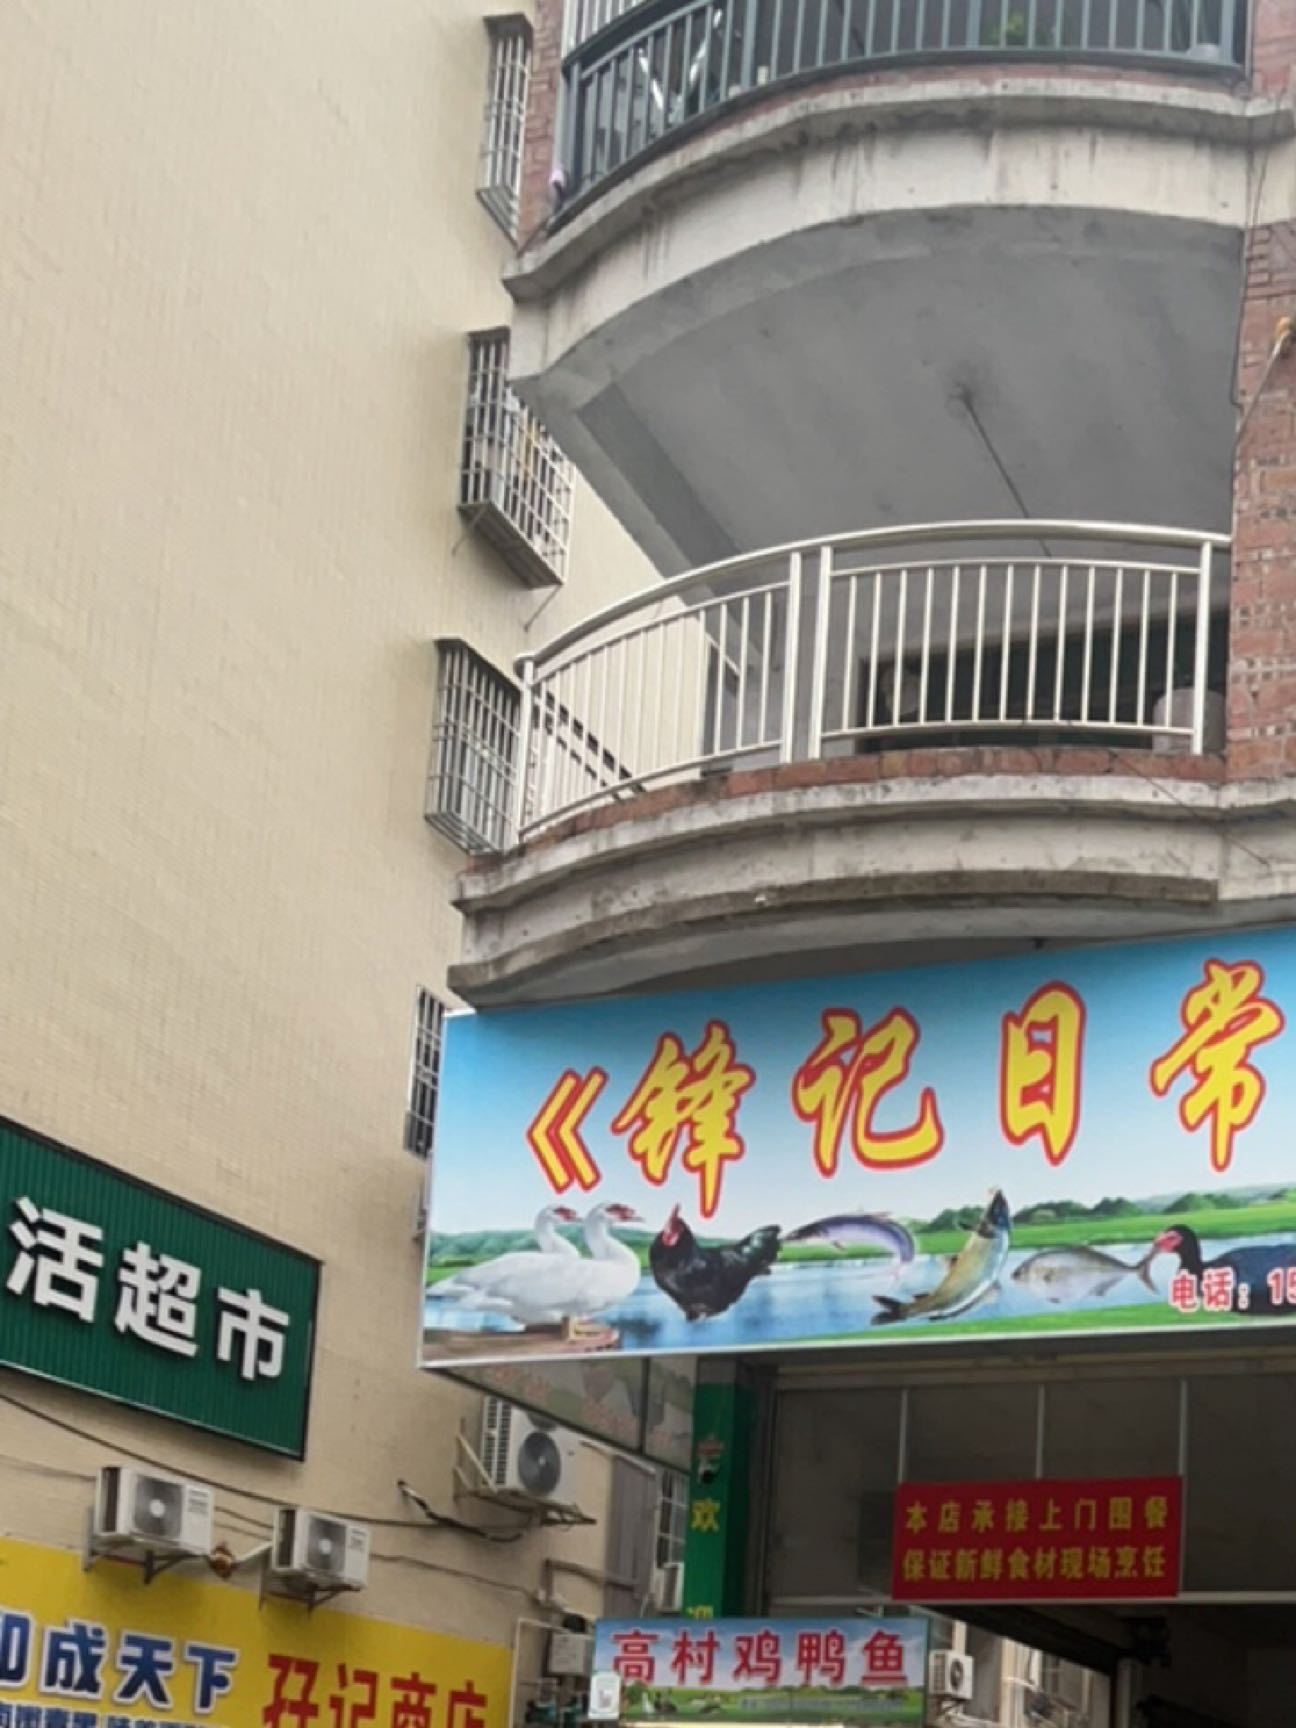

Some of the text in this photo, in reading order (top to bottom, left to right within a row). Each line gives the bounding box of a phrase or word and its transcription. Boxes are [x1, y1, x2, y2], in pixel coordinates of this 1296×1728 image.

[6, 1196, 289, 1380] 活超市
[905, 1496, 1167, 1533] 本店承接上门围餐
[903, 1547, 1165, 1582] 保证新鲜食材现场烹饪
[612, 1629, 907, 1686] 高村鸡鸭鱼
